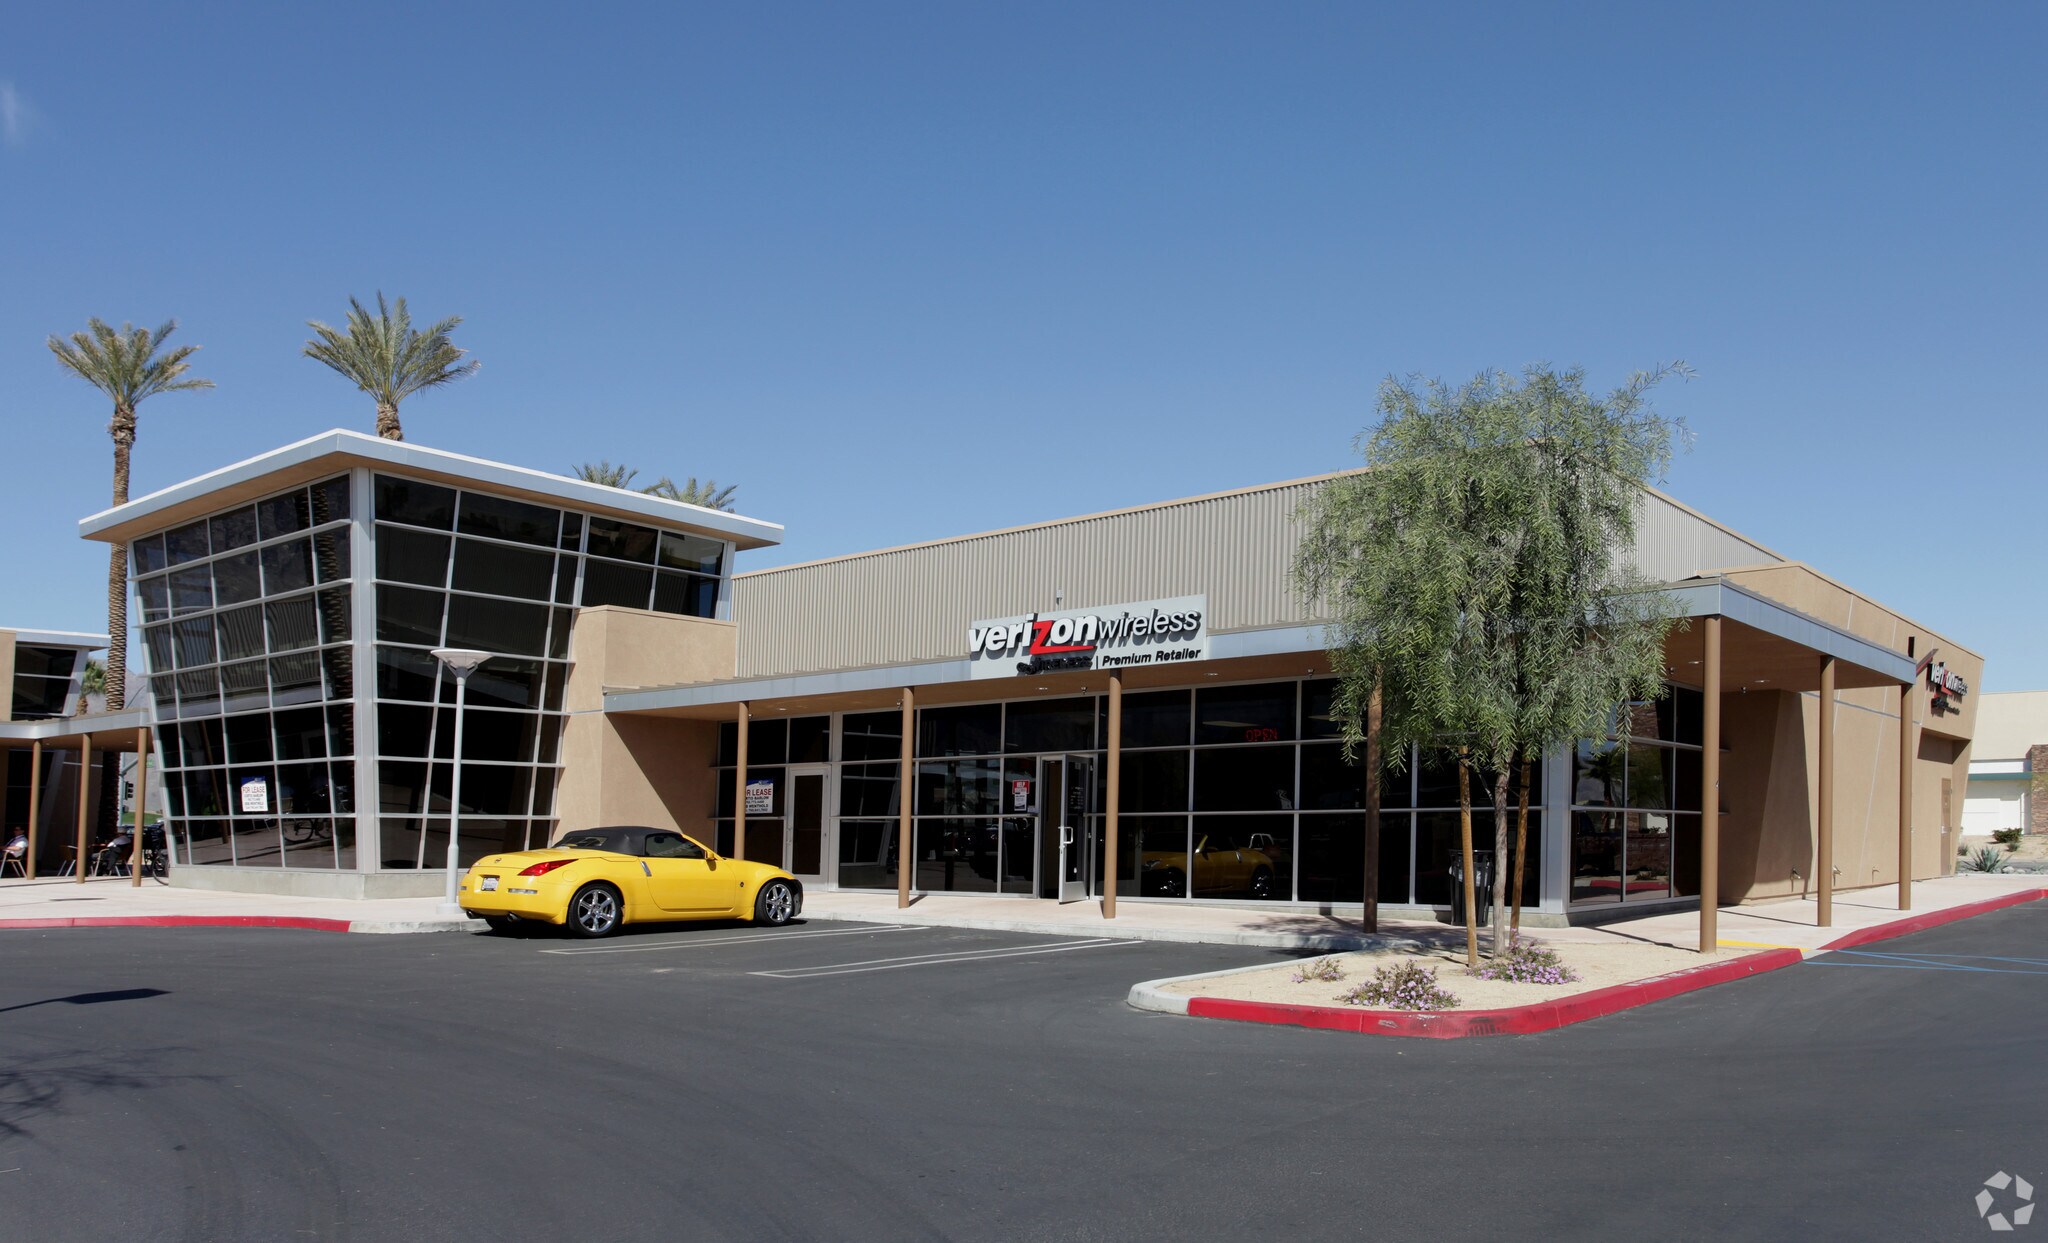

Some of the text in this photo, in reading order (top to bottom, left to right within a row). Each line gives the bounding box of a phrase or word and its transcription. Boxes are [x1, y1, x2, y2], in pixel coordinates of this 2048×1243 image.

[968, 608, 1200, 655] verizon wireless
[1102, 647, 1201, 667] Premium Retailer
[1245, 728, 1278, 742] OPEN
[752, 788, 772, 796] LEASE
